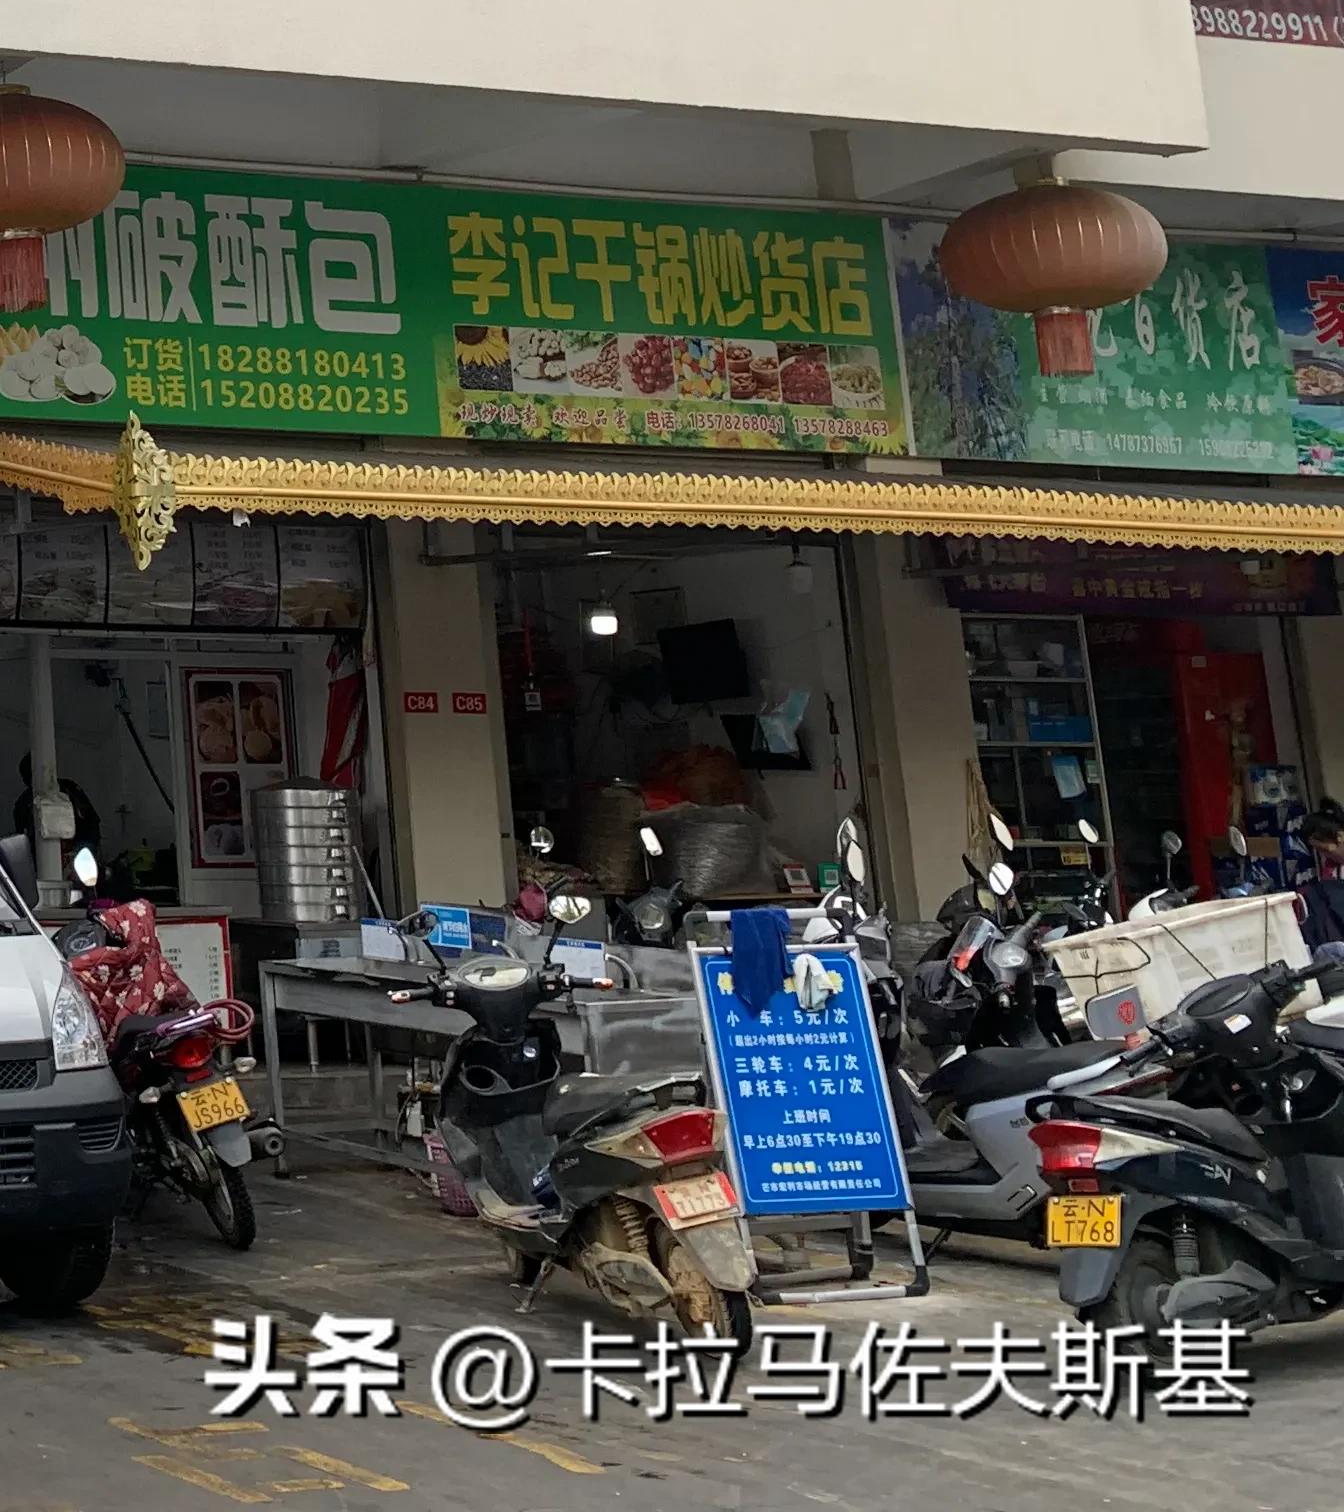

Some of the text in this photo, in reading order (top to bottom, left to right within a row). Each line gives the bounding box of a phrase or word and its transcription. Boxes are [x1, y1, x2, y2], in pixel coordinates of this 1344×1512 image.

[447, 212, 874, 336] 李记干锅炒货店
[123, 337, 406, 381] 订货 18288180413
[124, 374, 409, 416] 电话 15208820235
[553, 405, 628, 429] 欢迎品尝
[689, 413, 784, 433] 13578268041
[794, 417, 889, 438] 13578288463
[407, 695, 435, 710] C84
[455, 695, 483, 711] C85
[190, 1082, 231, 1107] 云·N
[193, 1096, 245, 1129] JS966
[783, 1109, 832, 1125] 上班时间
[743, 1131, 882, 1150] 早上6点30至下午19点30
[1062, 1199, 1106, 1218] 云·N
[1051, 1220, 1115, 1243] LT768
